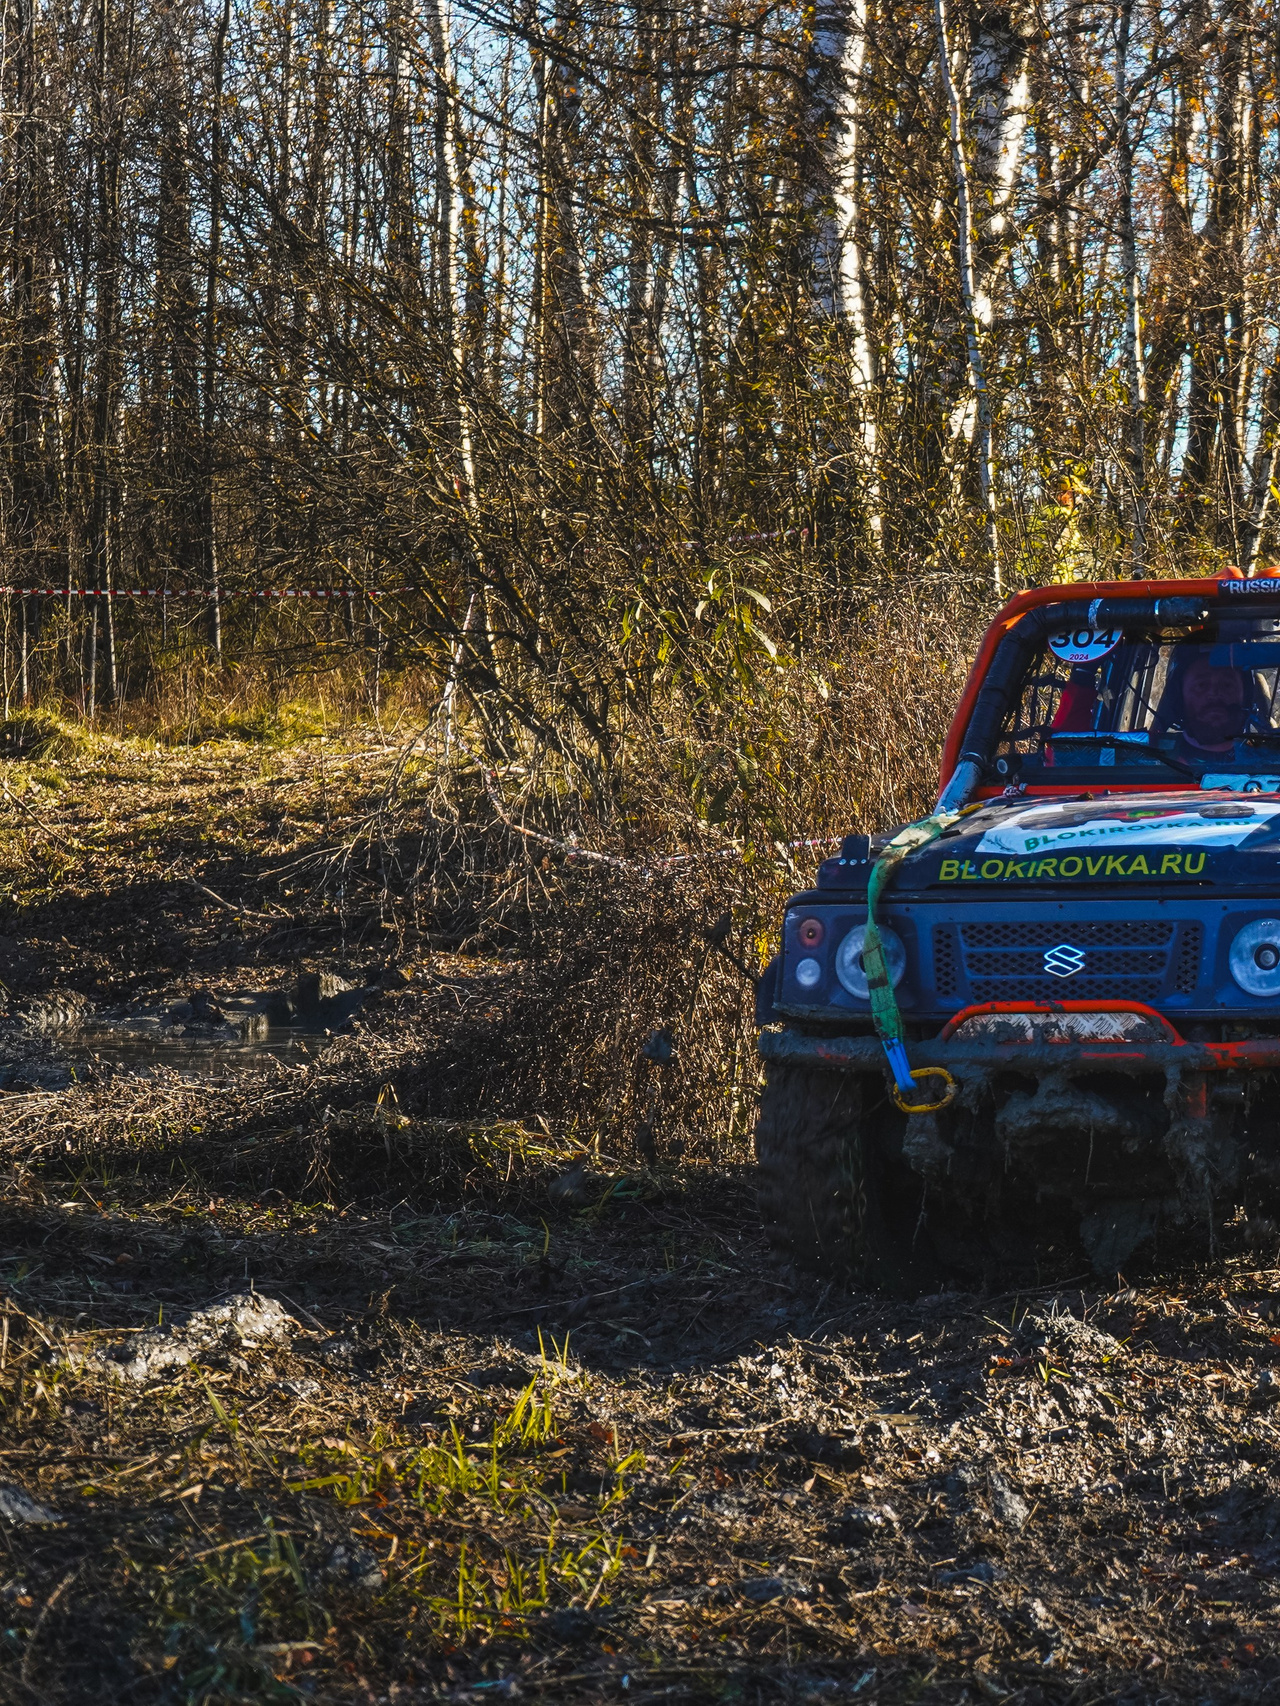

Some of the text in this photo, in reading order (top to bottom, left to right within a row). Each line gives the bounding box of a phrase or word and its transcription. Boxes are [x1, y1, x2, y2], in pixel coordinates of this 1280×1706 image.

[1051, 628, 1115, 648] 304
[1024, 820, 1250, 851] BLOKIROVKA.RU
[939, 852, 1206, 881] BLOKIROVKA.RU
